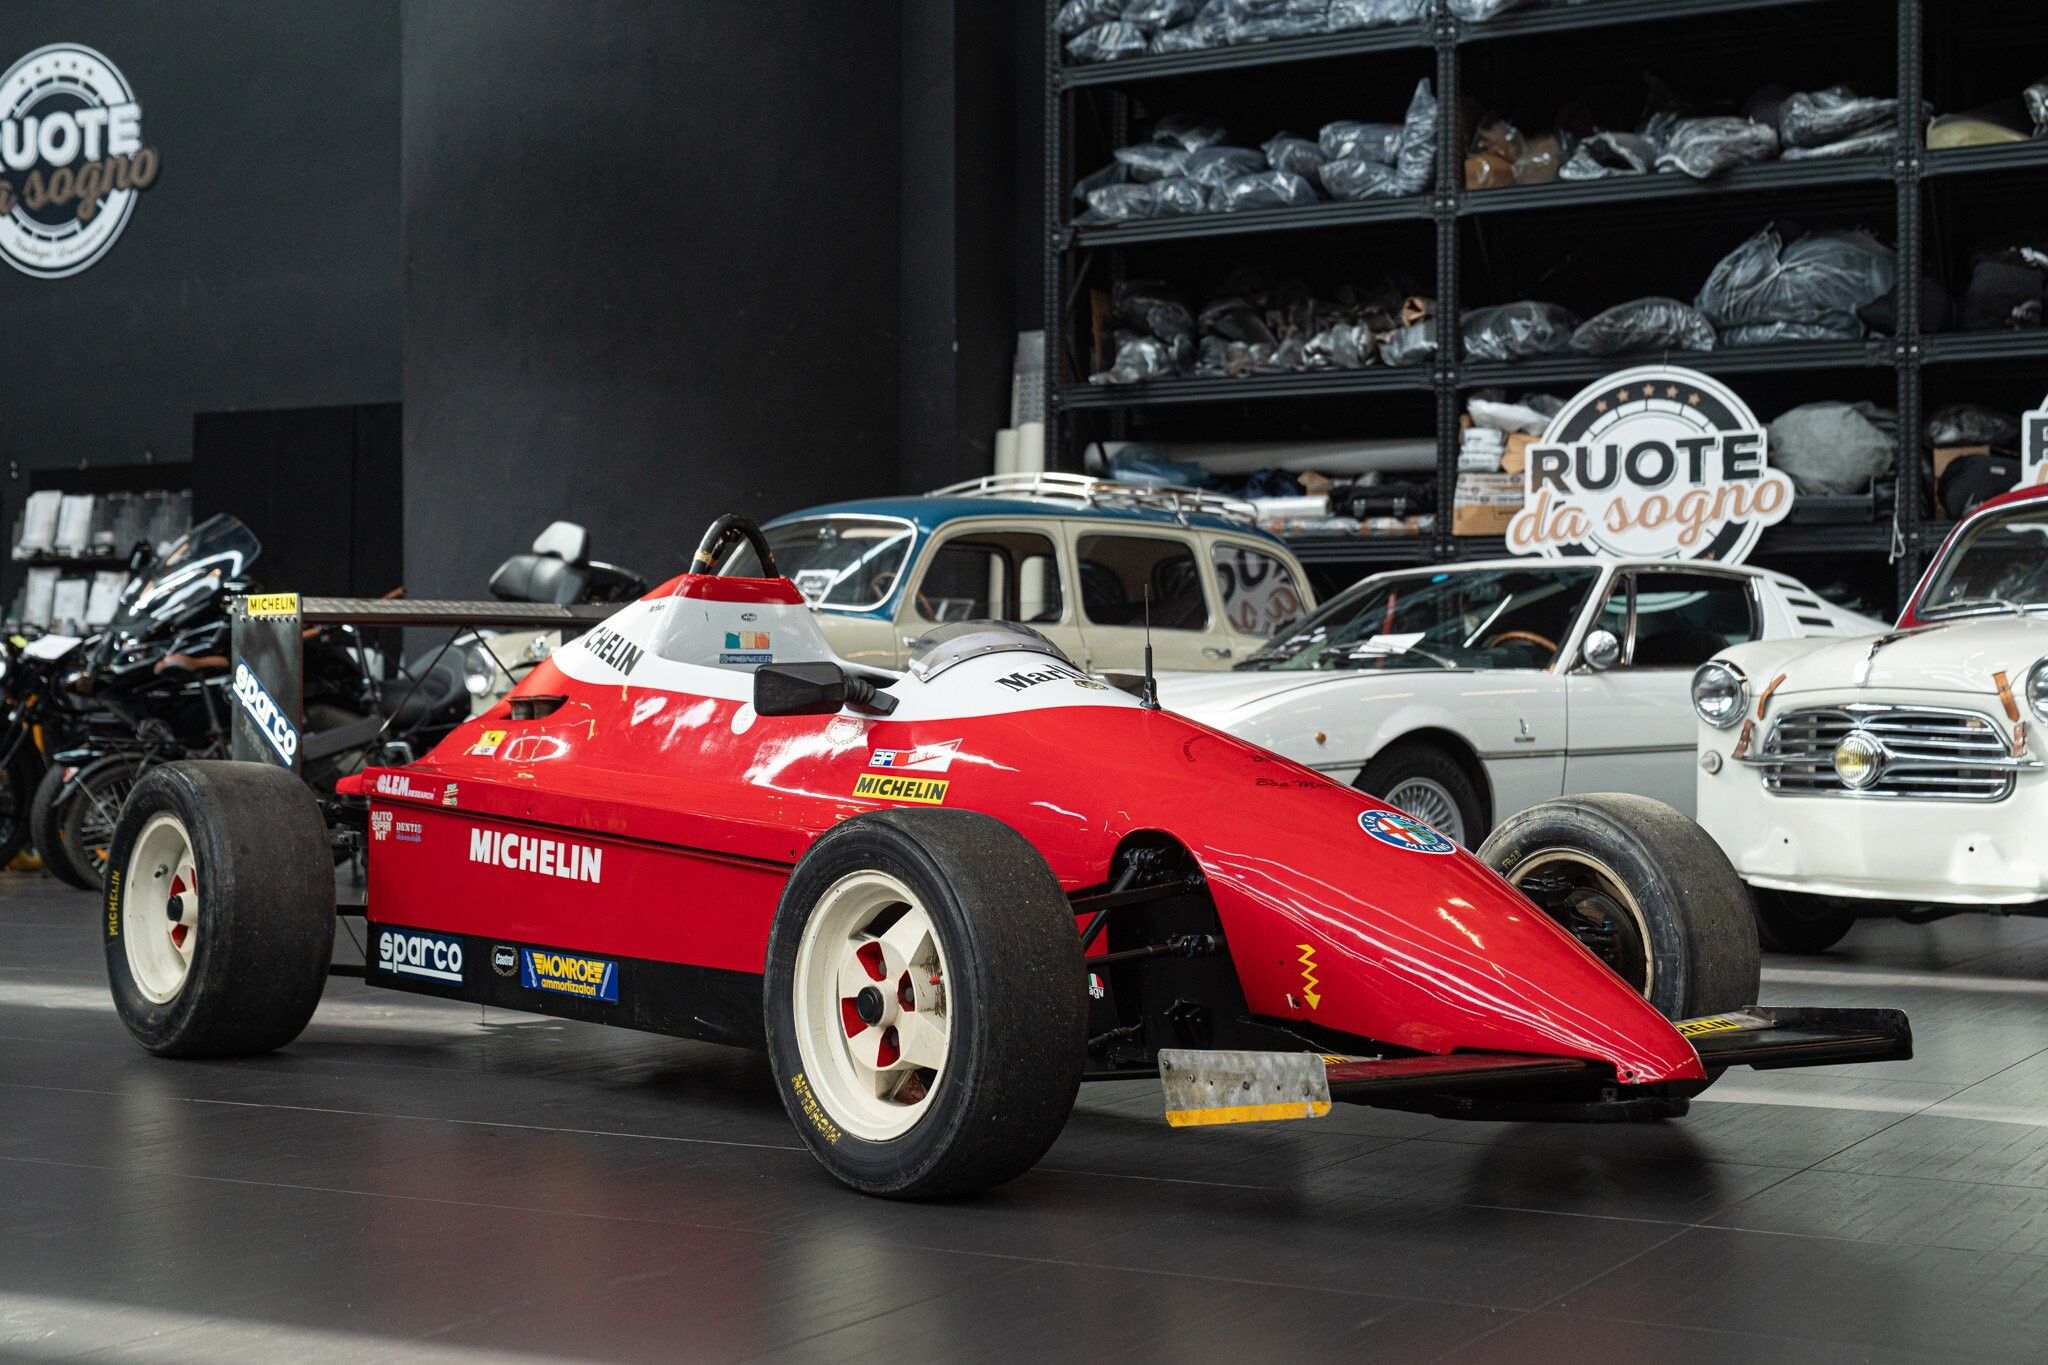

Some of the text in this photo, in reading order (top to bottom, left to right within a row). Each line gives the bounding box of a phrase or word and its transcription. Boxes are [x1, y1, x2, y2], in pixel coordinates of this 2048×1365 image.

[0, 103, 142, 173] UOTE
[22, 148, 158, 220] sogno
[1531, 435, 1761, 495] RUOTE
[1513, 479, 1785, 546] da sogno
[250, 598, 296, 611] MICHELIN
[582, 626, 645, 677] CHELIN
[729, 655, 771, 663] PIONEER
[235, 663, 298, 757] sparco
[857, 778, 946, 801] MICHELIN
[371, 811, 393, 821] AUTO
[375, 831, 387, 841] NT
[469, 827, 603, 884] MICHELIN
[109, 870, 120, 936] MICHELIN
[380, 931, 463, 974] sparco
[533, 953, 605, 984] MONROE
[541, 979, 596, 996] ammortizzatori
